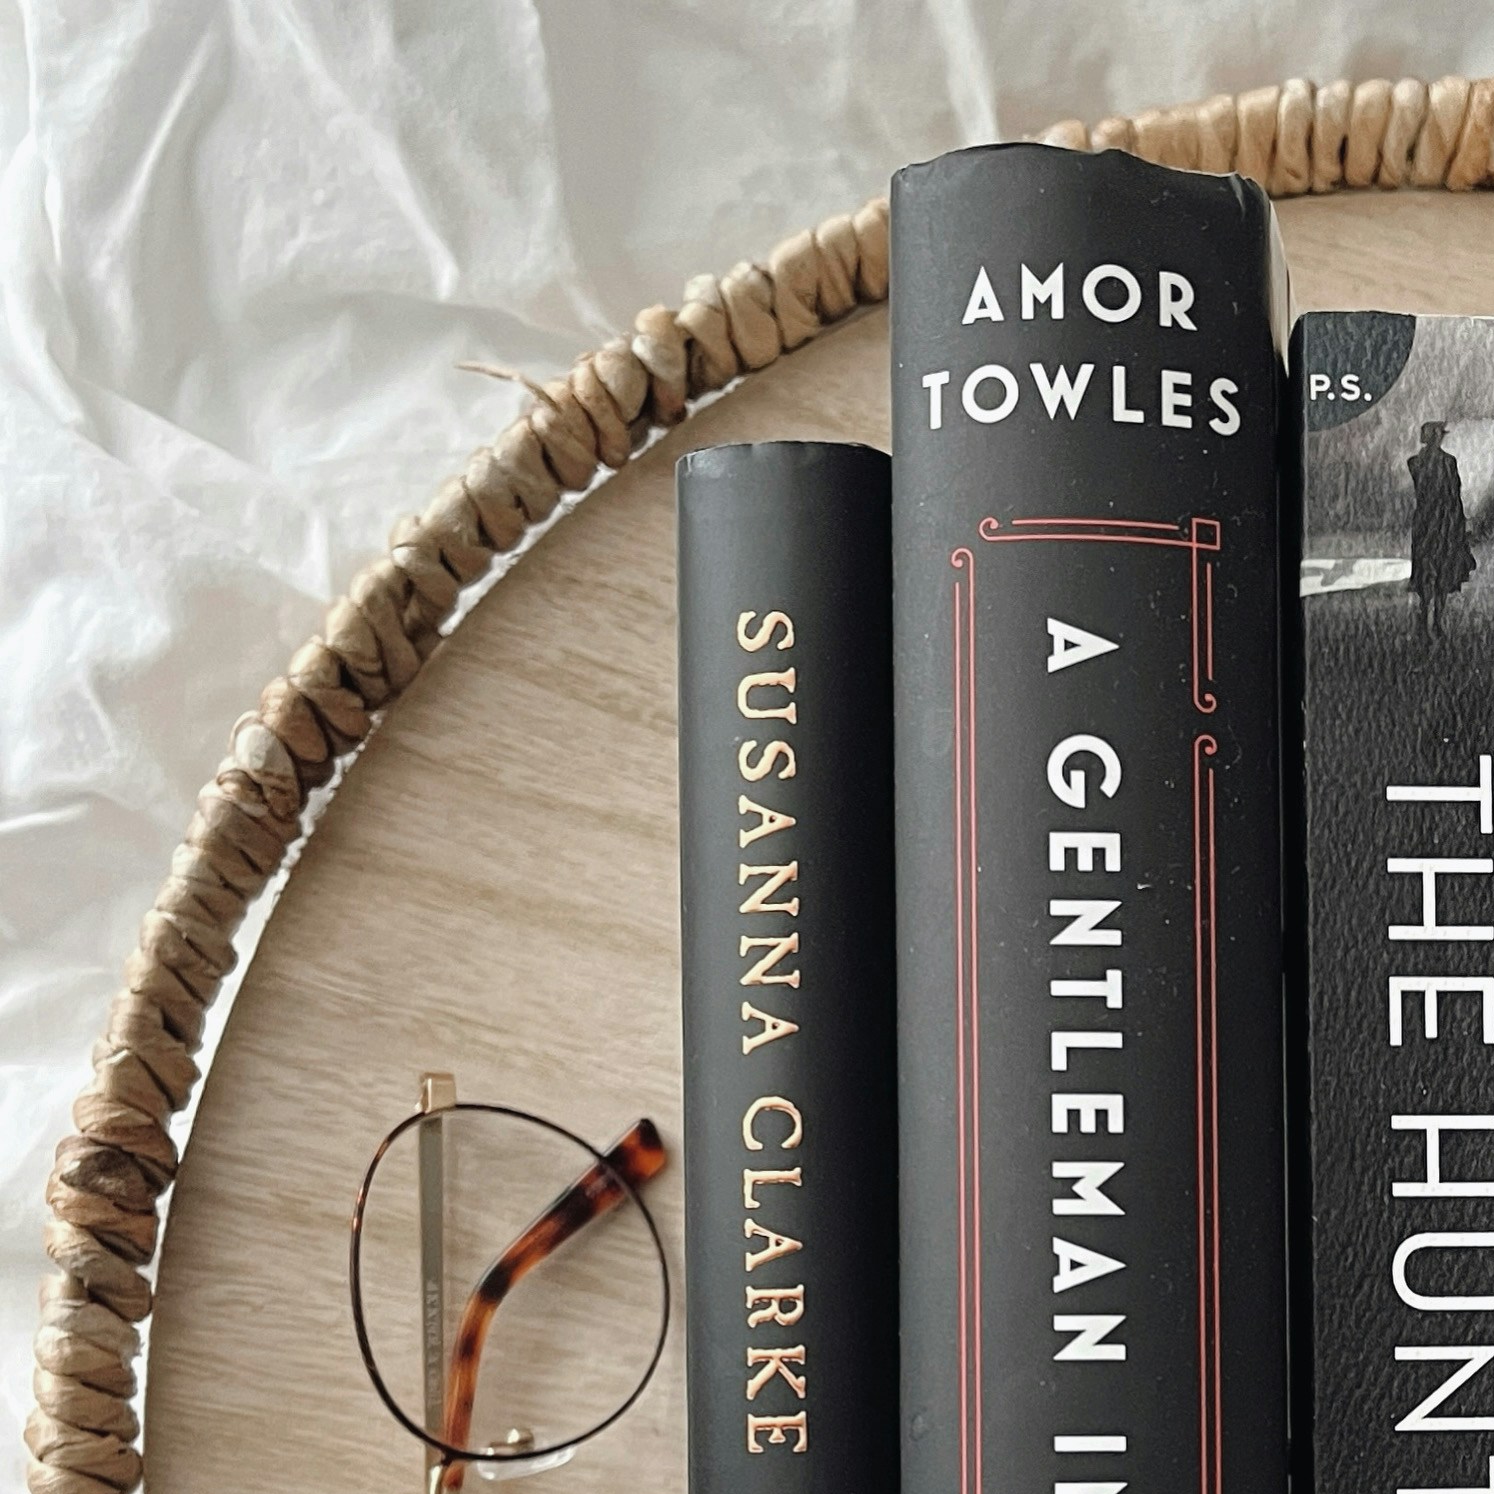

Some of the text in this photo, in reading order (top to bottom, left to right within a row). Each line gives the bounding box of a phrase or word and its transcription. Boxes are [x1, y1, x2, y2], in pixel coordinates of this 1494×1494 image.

[961, 263, 1199, 333] AMOR
[921, 362, 1243, 437] TOWLES
[1310, 374, 1372, 401] P.S.
[1046, 617, 1120, 673] A
[736, 610, 807, 1454] SUSANNA CLARKE
[1046, 734, 1127, 1361] GENTLEMAN
